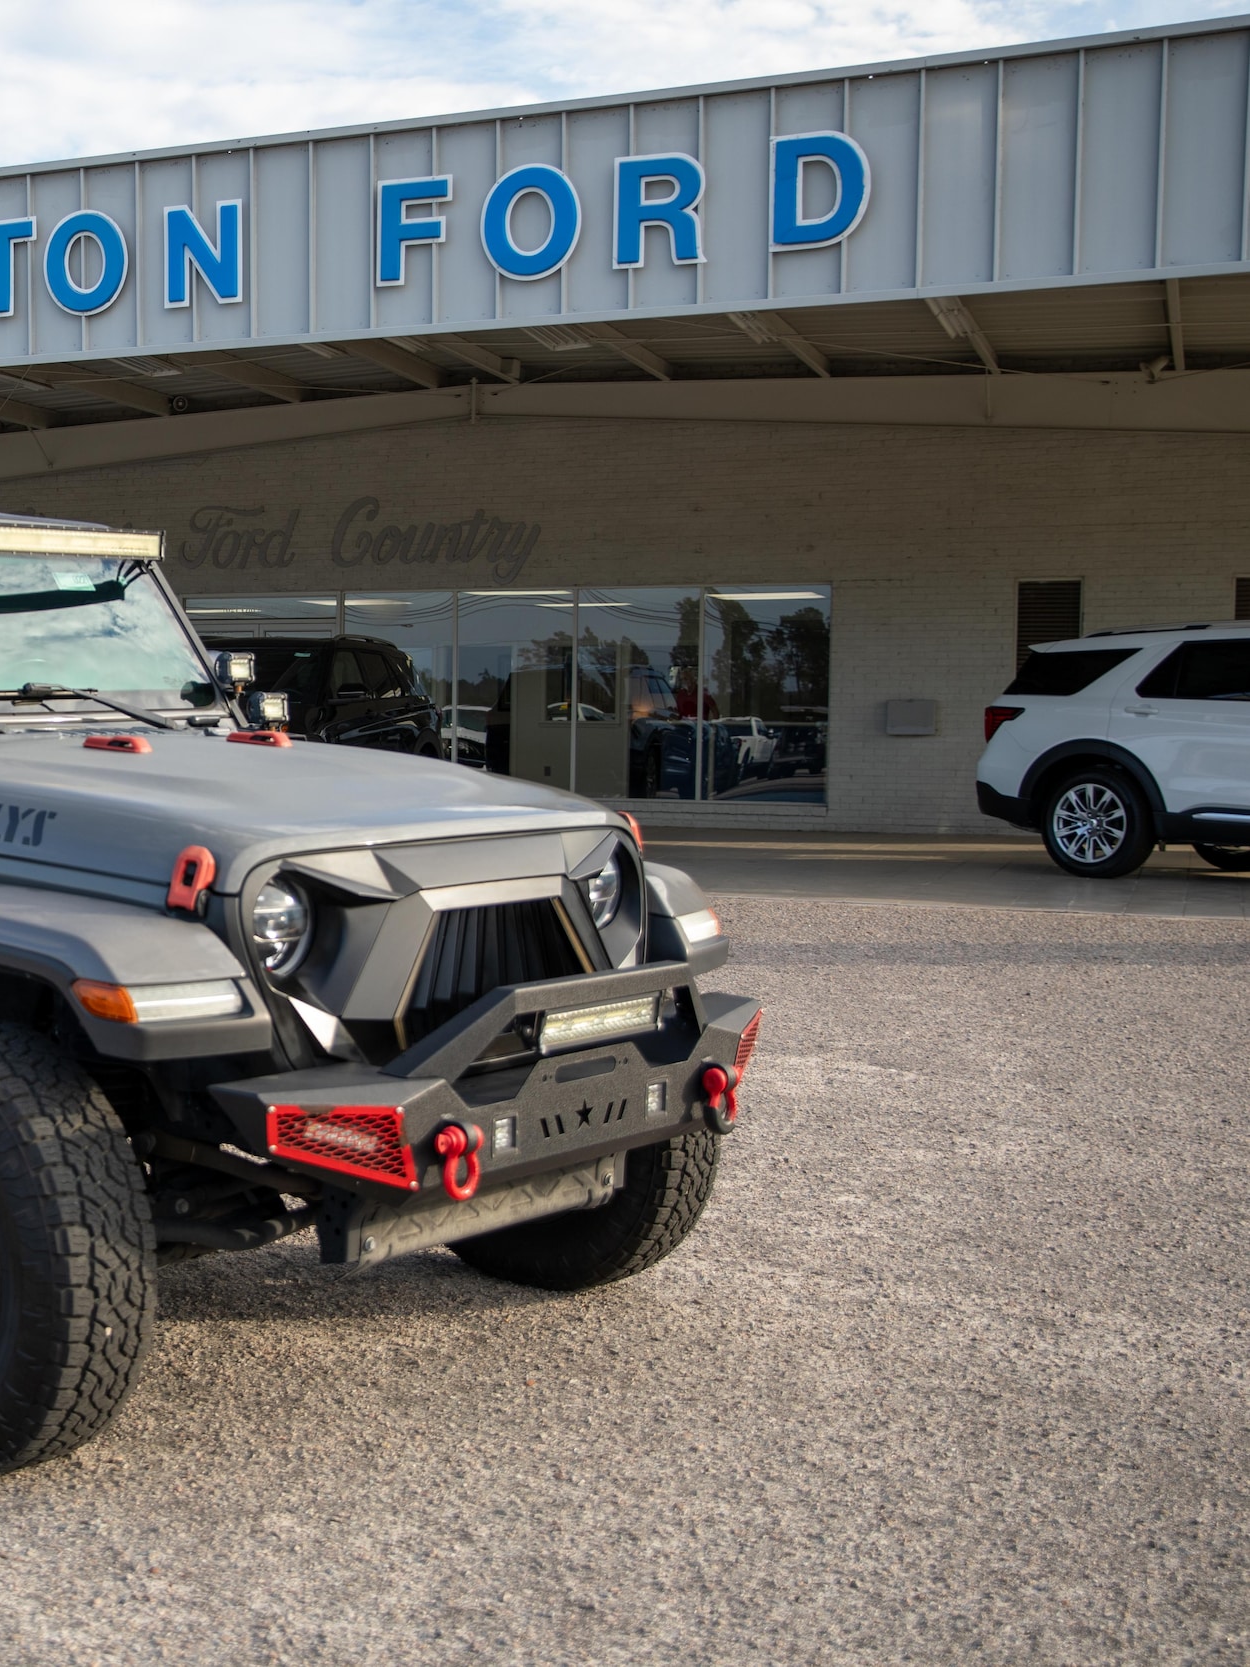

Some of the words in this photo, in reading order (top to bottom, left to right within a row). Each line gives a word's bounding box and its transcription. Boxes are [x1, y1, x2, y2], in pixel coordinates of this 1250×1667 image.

[376, 130, 871, 287] FORD
[178, 505, 299, 570] Ford
[331, 496, 541, 585] Country
